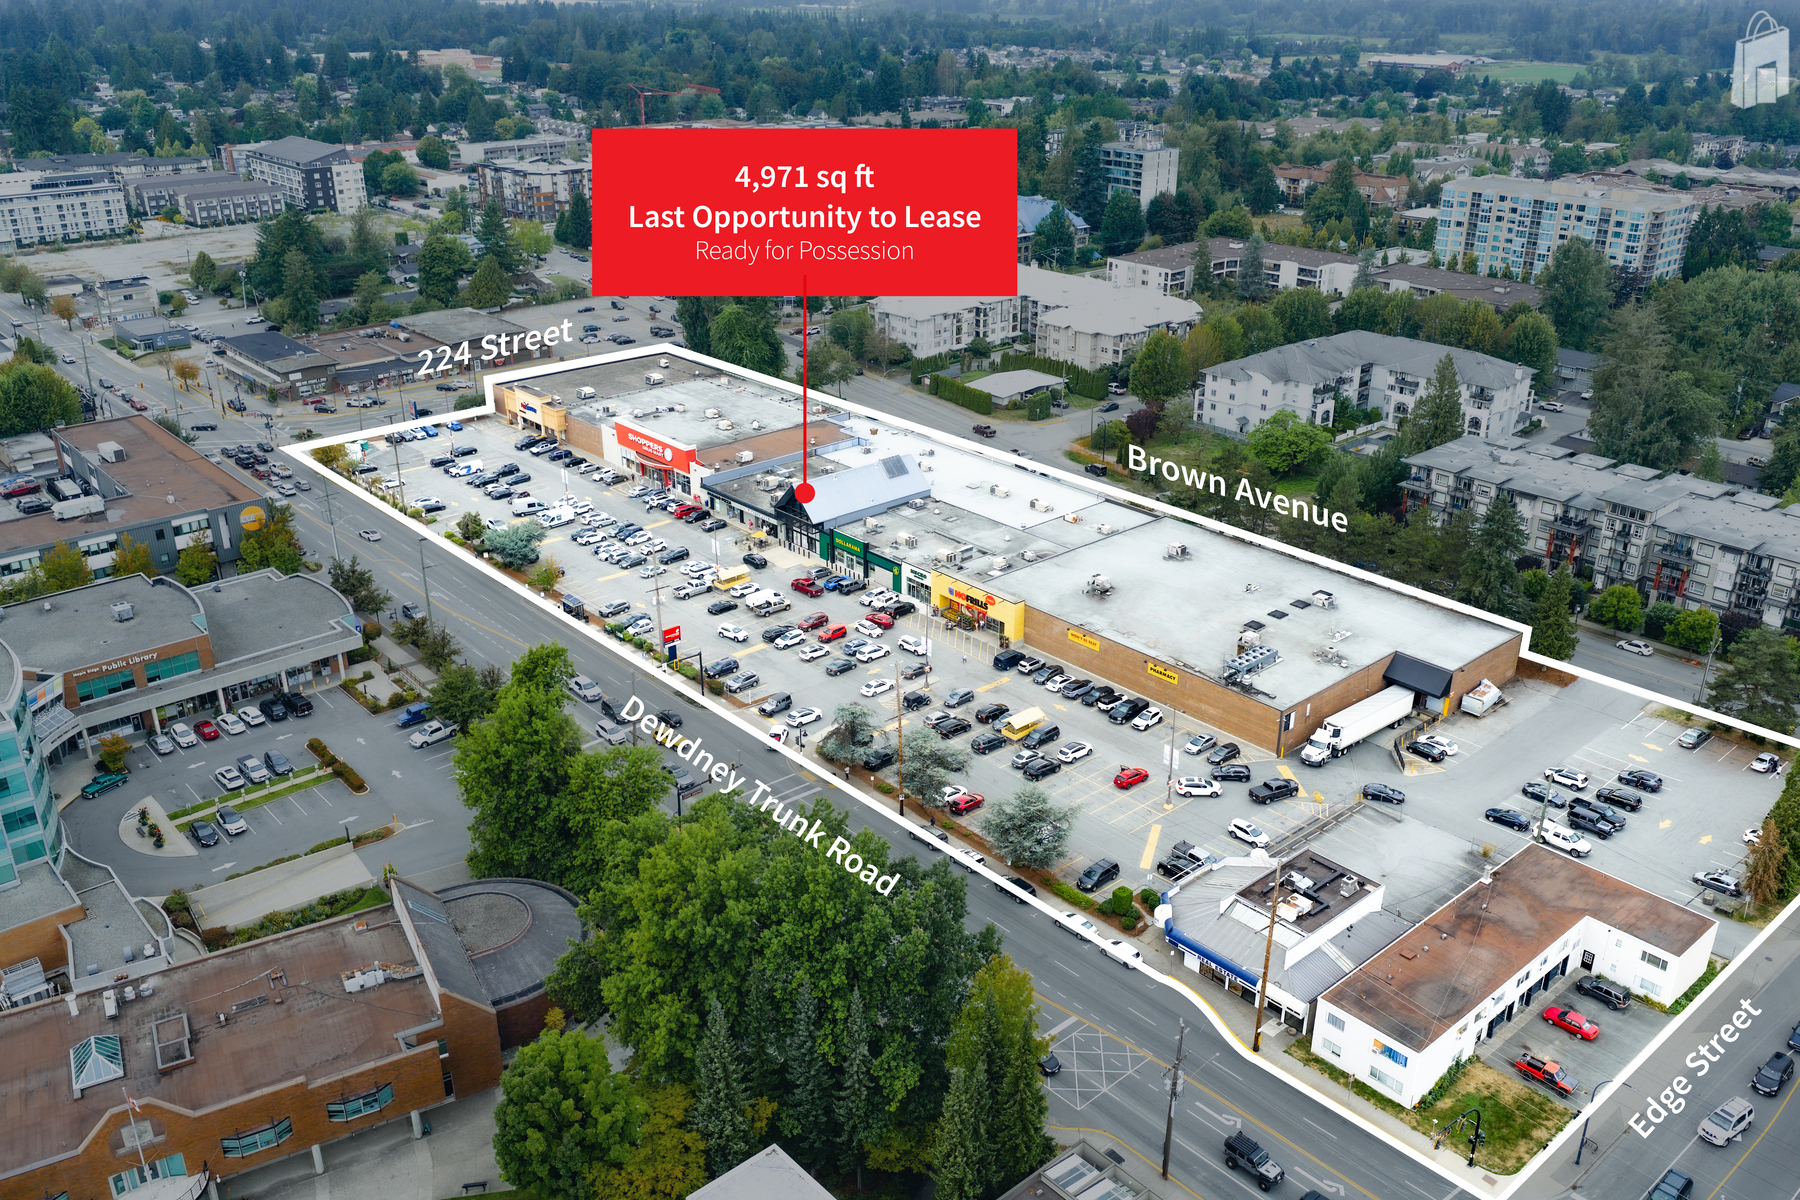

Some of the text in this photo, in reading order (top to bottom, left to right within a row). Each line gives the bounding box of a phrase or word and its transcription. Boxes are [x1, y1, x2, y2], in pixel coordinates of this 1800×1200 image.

[628, 433, 663, 453] SHOPPERS
[835, 538, 861, 553] DOLLARAMA
[72, 670, 87, 678] Maple
[102, 660, 127, 672] Public
[128, 652, 158, 665] Library
[1149, 666, 1176, 681] PHARMACY
[1197, 956, 1239, 982] REAL ESTATE
